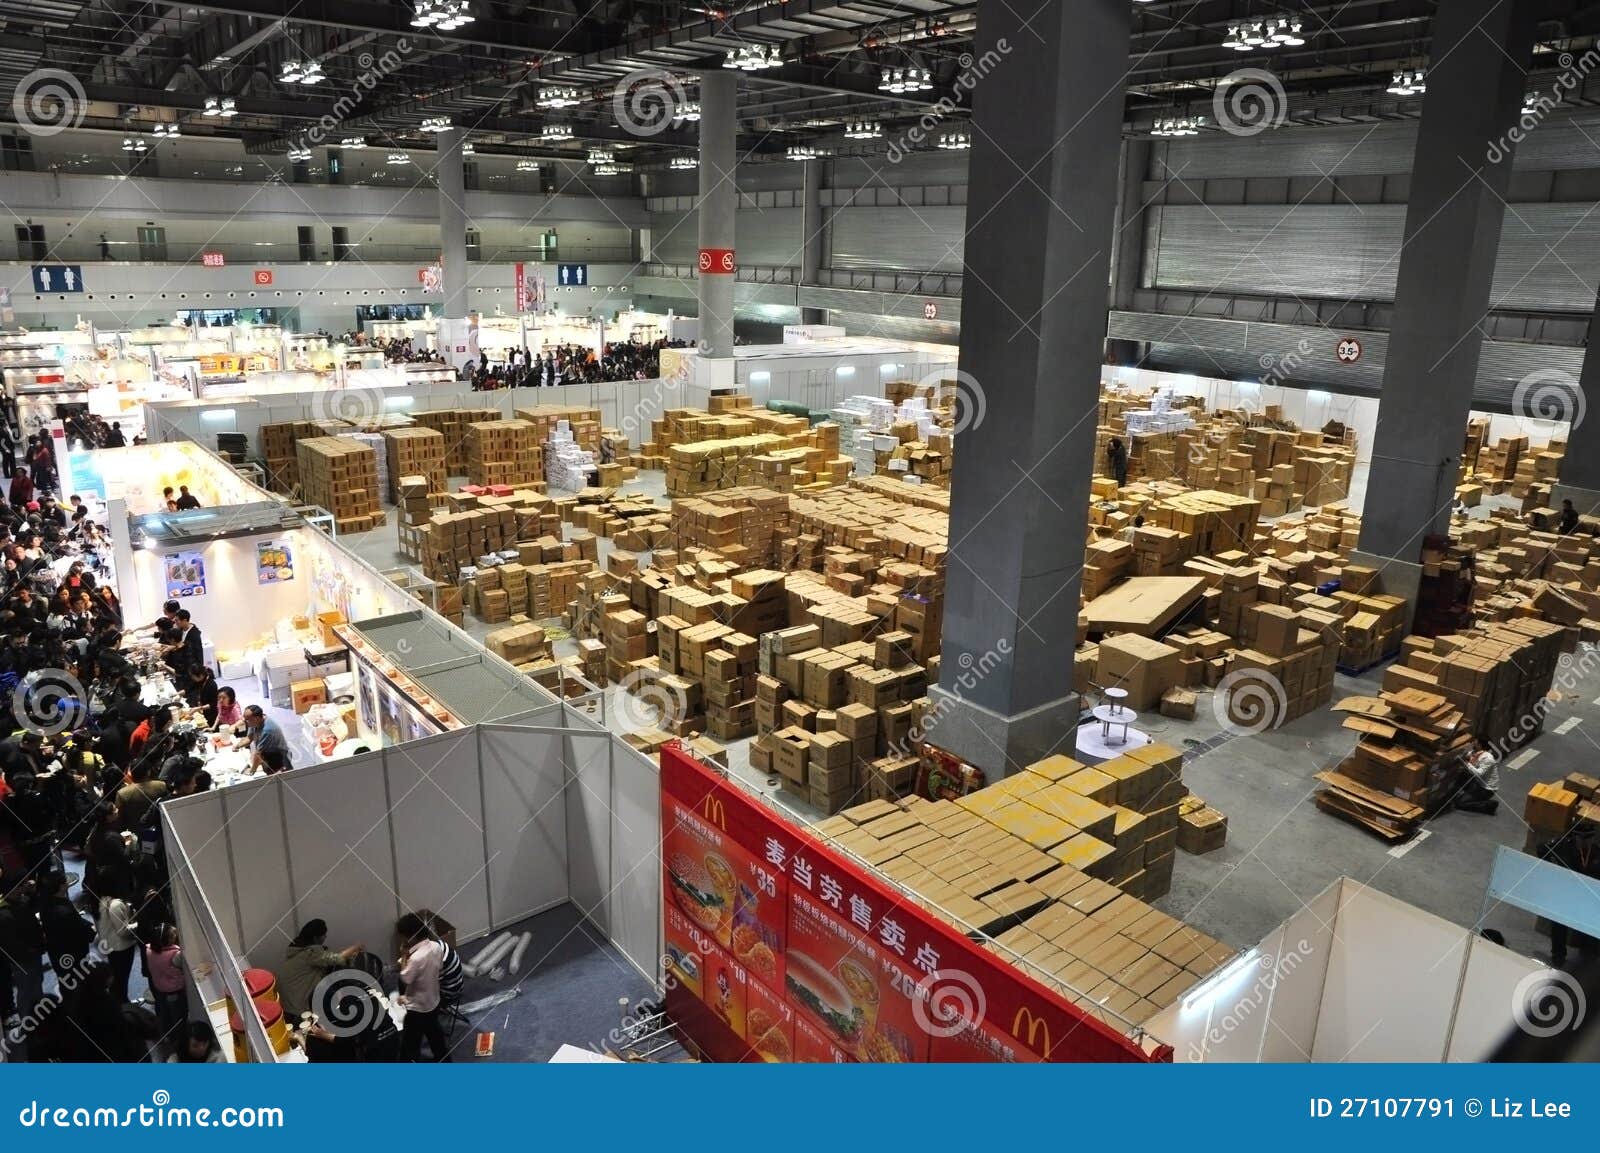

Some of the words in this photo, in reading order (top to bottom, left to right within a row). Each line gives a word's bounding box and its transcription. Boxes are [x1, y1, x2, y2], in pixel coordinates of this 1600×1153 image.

[765, 836, 940, 980] 麦当劳售卖点
